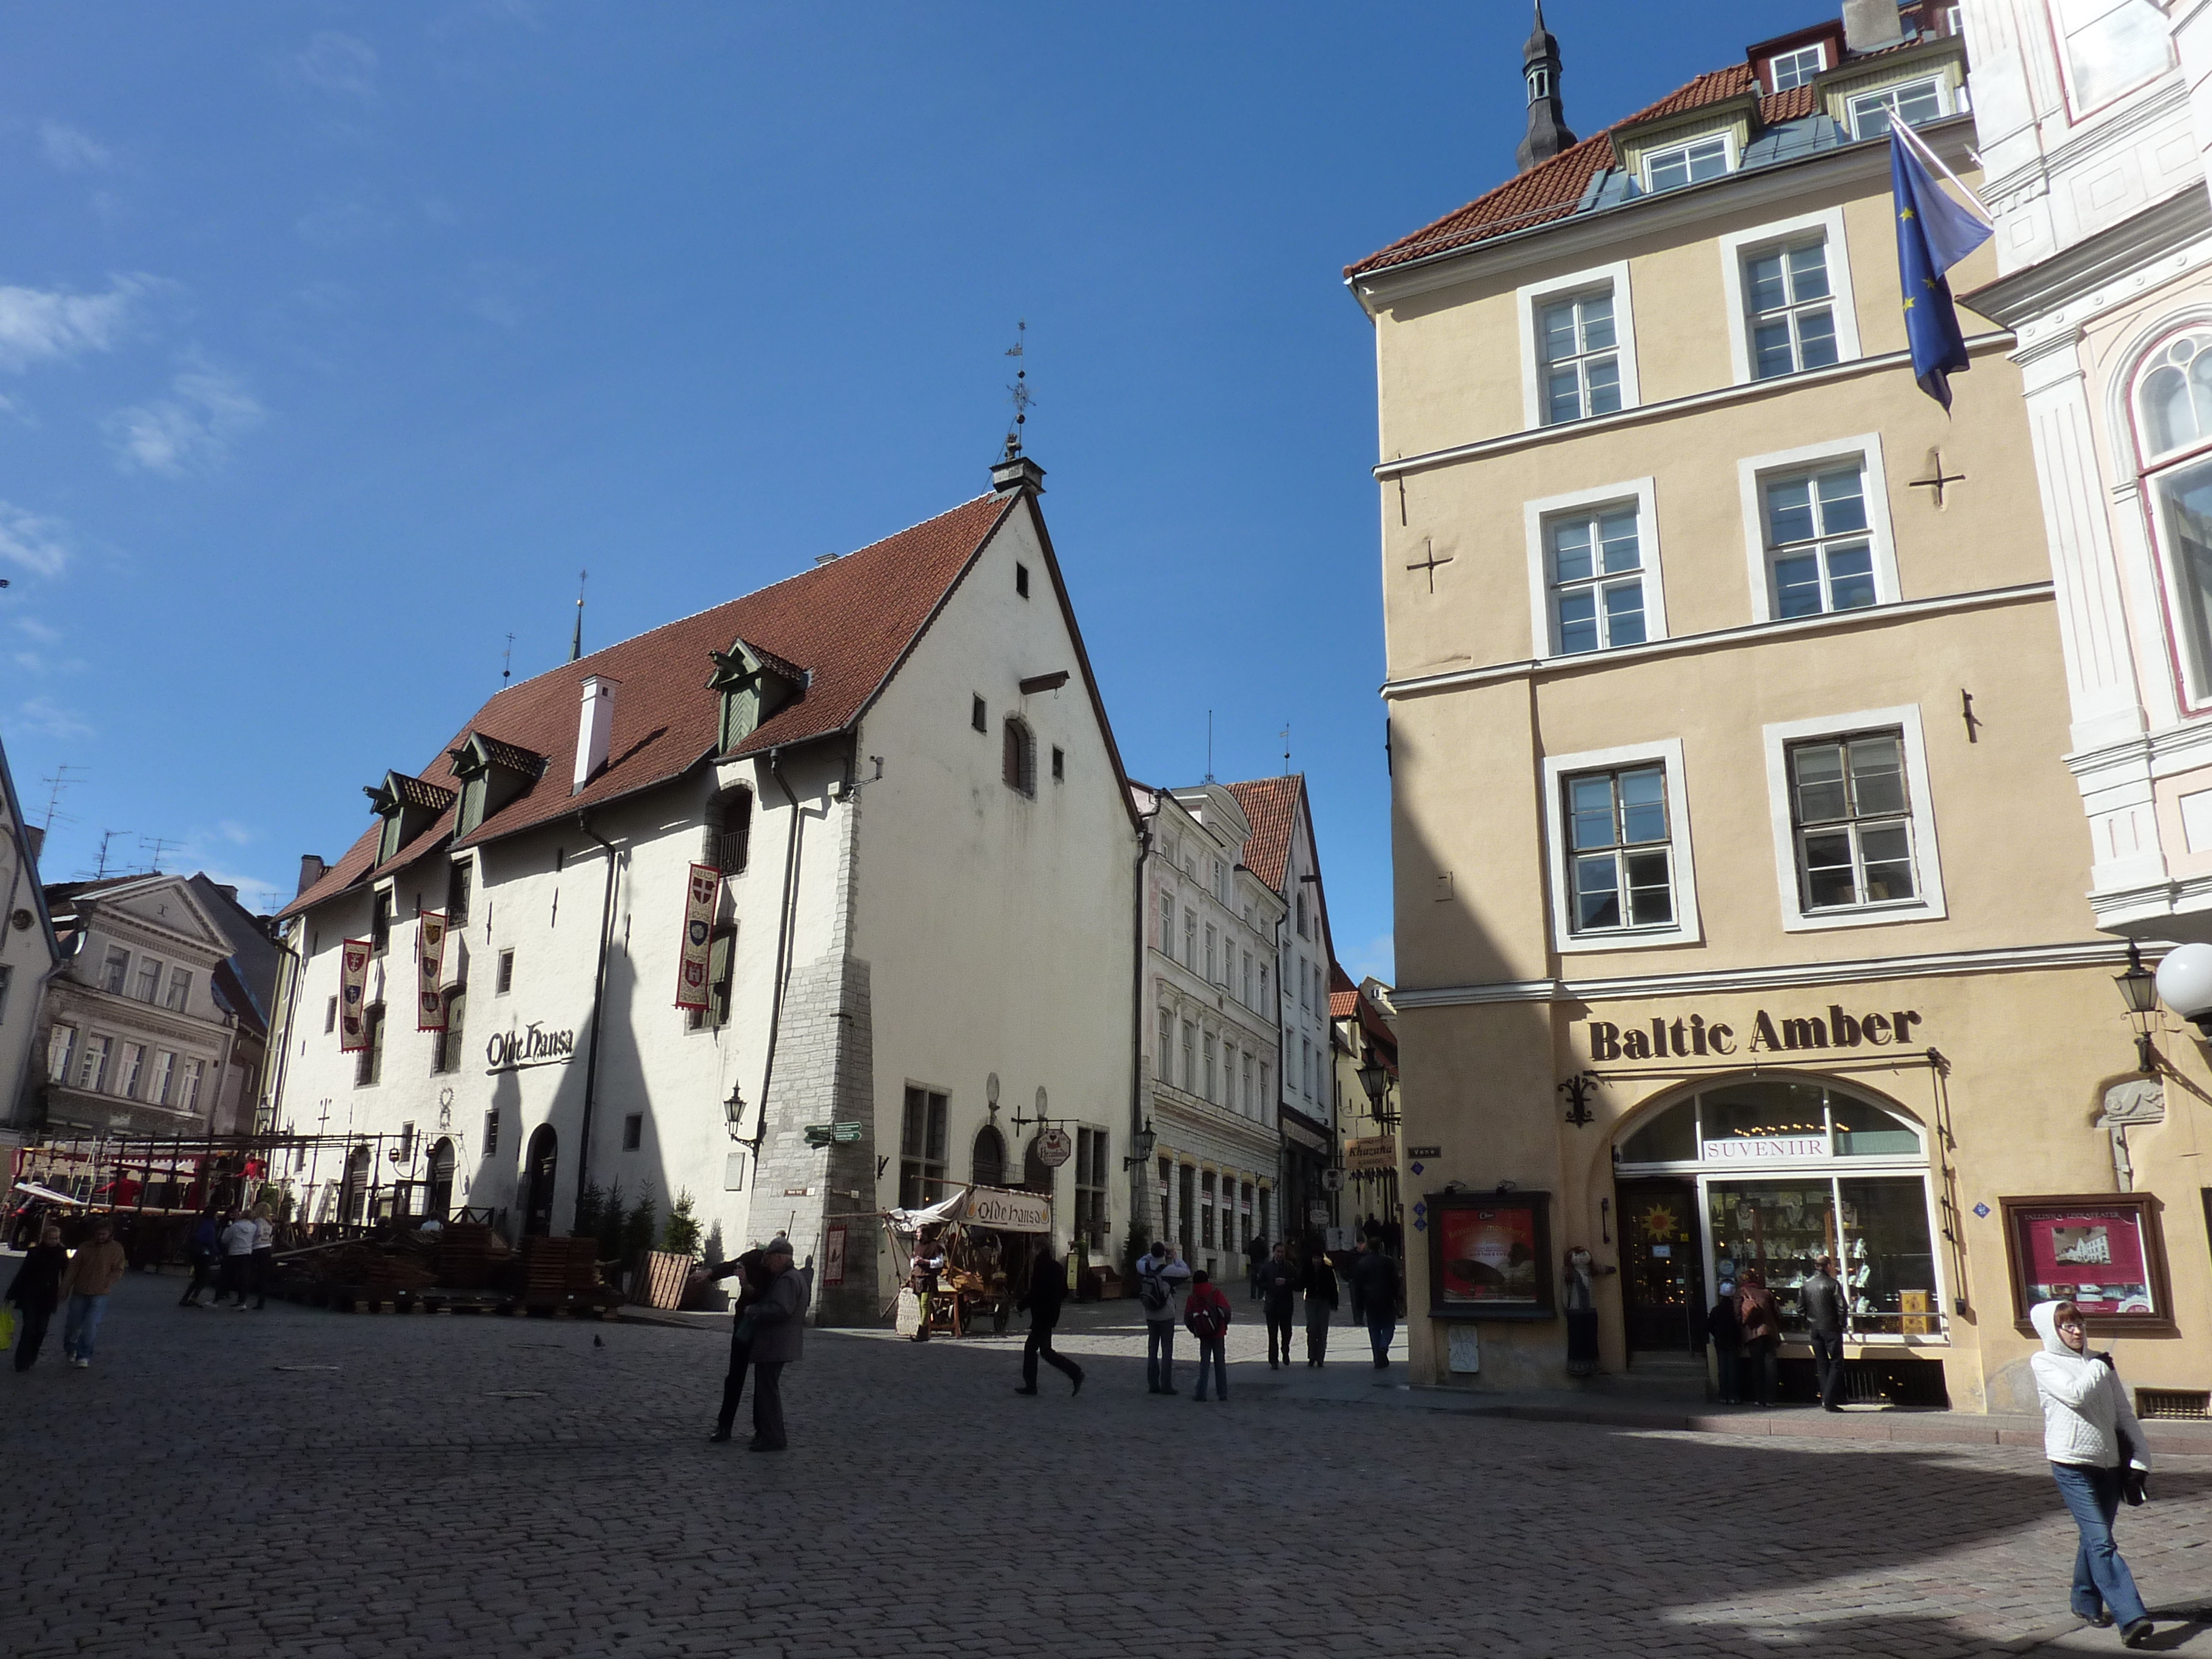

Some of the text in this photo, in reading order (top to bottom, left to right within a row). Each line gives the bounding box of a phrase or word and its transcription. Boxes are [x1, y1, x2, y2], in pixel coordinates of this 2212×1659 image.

[1587, 1005, 1922, 1062] Baltic Amber
[486, 1030, 523, 1067] Olde
[1708, 1139, 1823, 1158] SUVENIIR
[978, 1200, 1007, 1220] Olde
